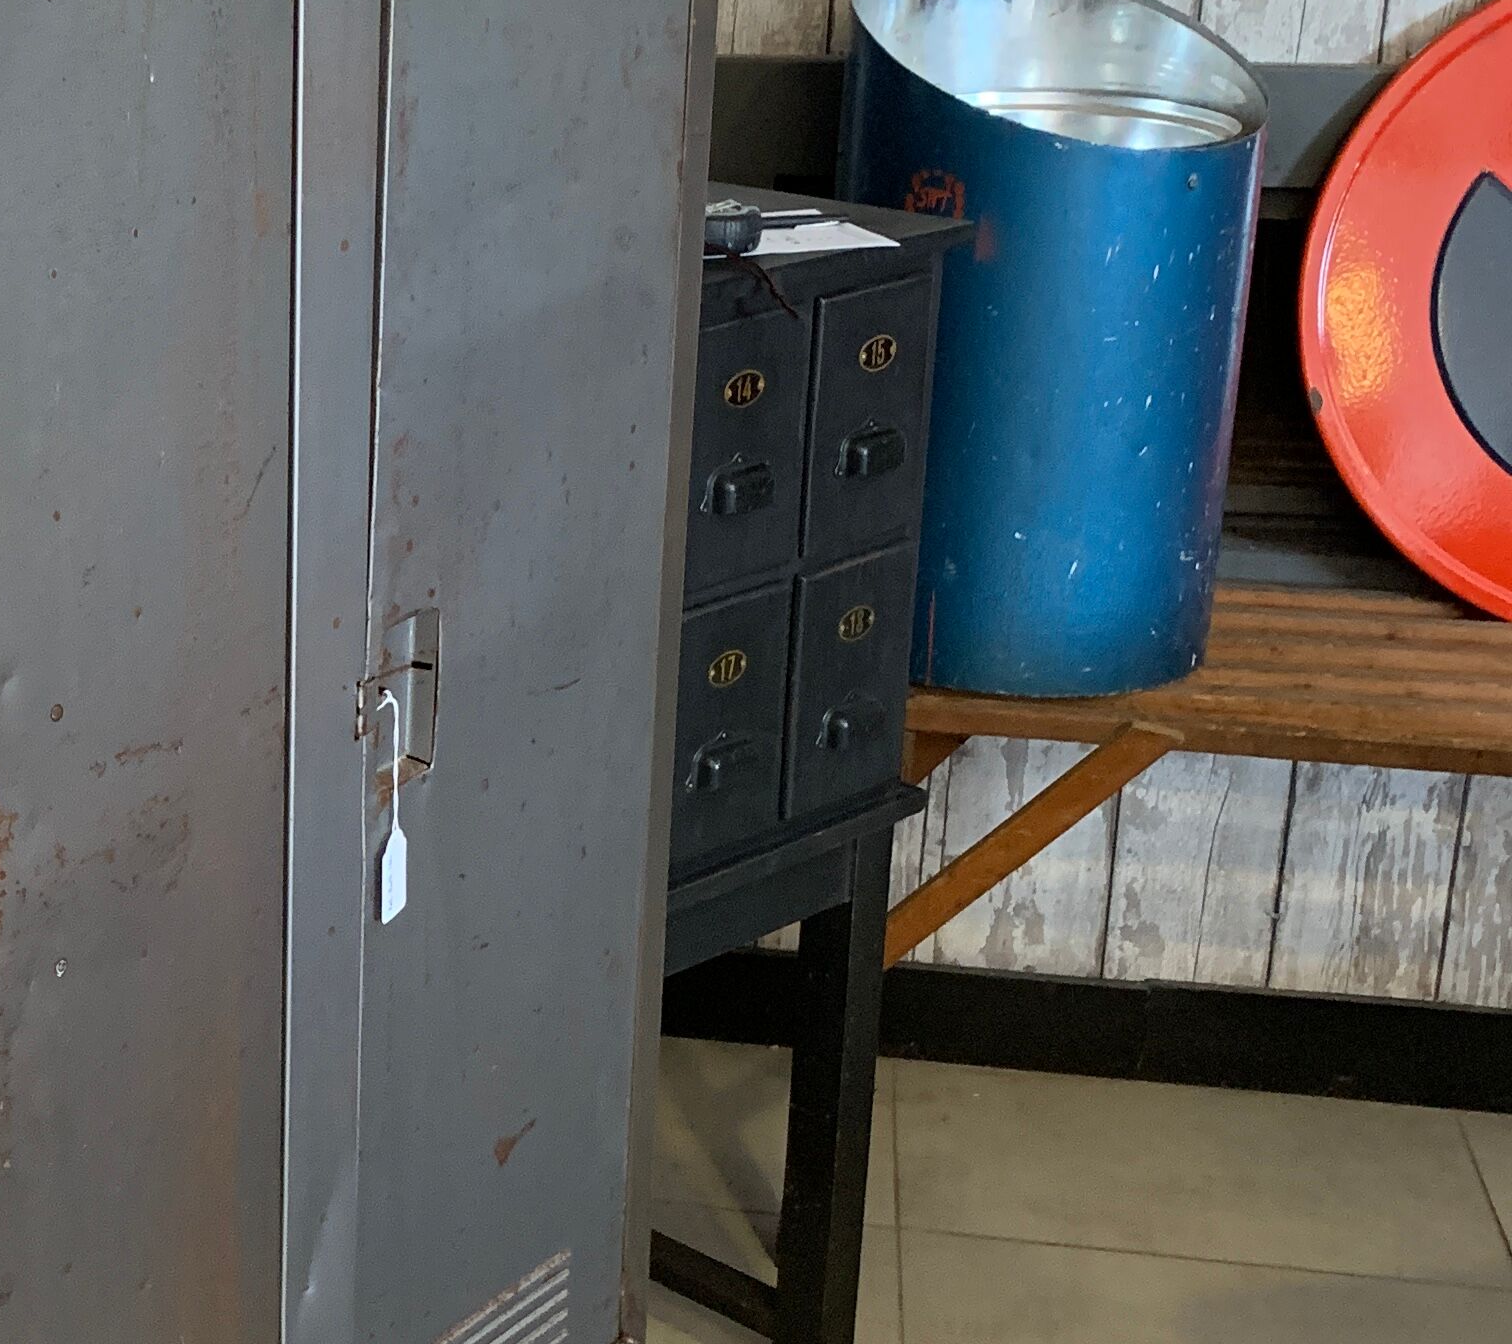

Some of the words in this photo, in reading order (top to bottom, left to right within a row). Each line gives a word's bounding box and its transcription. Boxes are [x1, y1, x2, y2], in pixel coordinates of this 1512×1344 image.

[871, 339, 885, 366] 15
[737, 375, 752, 403] 14
[850, 610, 864, 635] 18
[721, 656, 736, 681] 17
